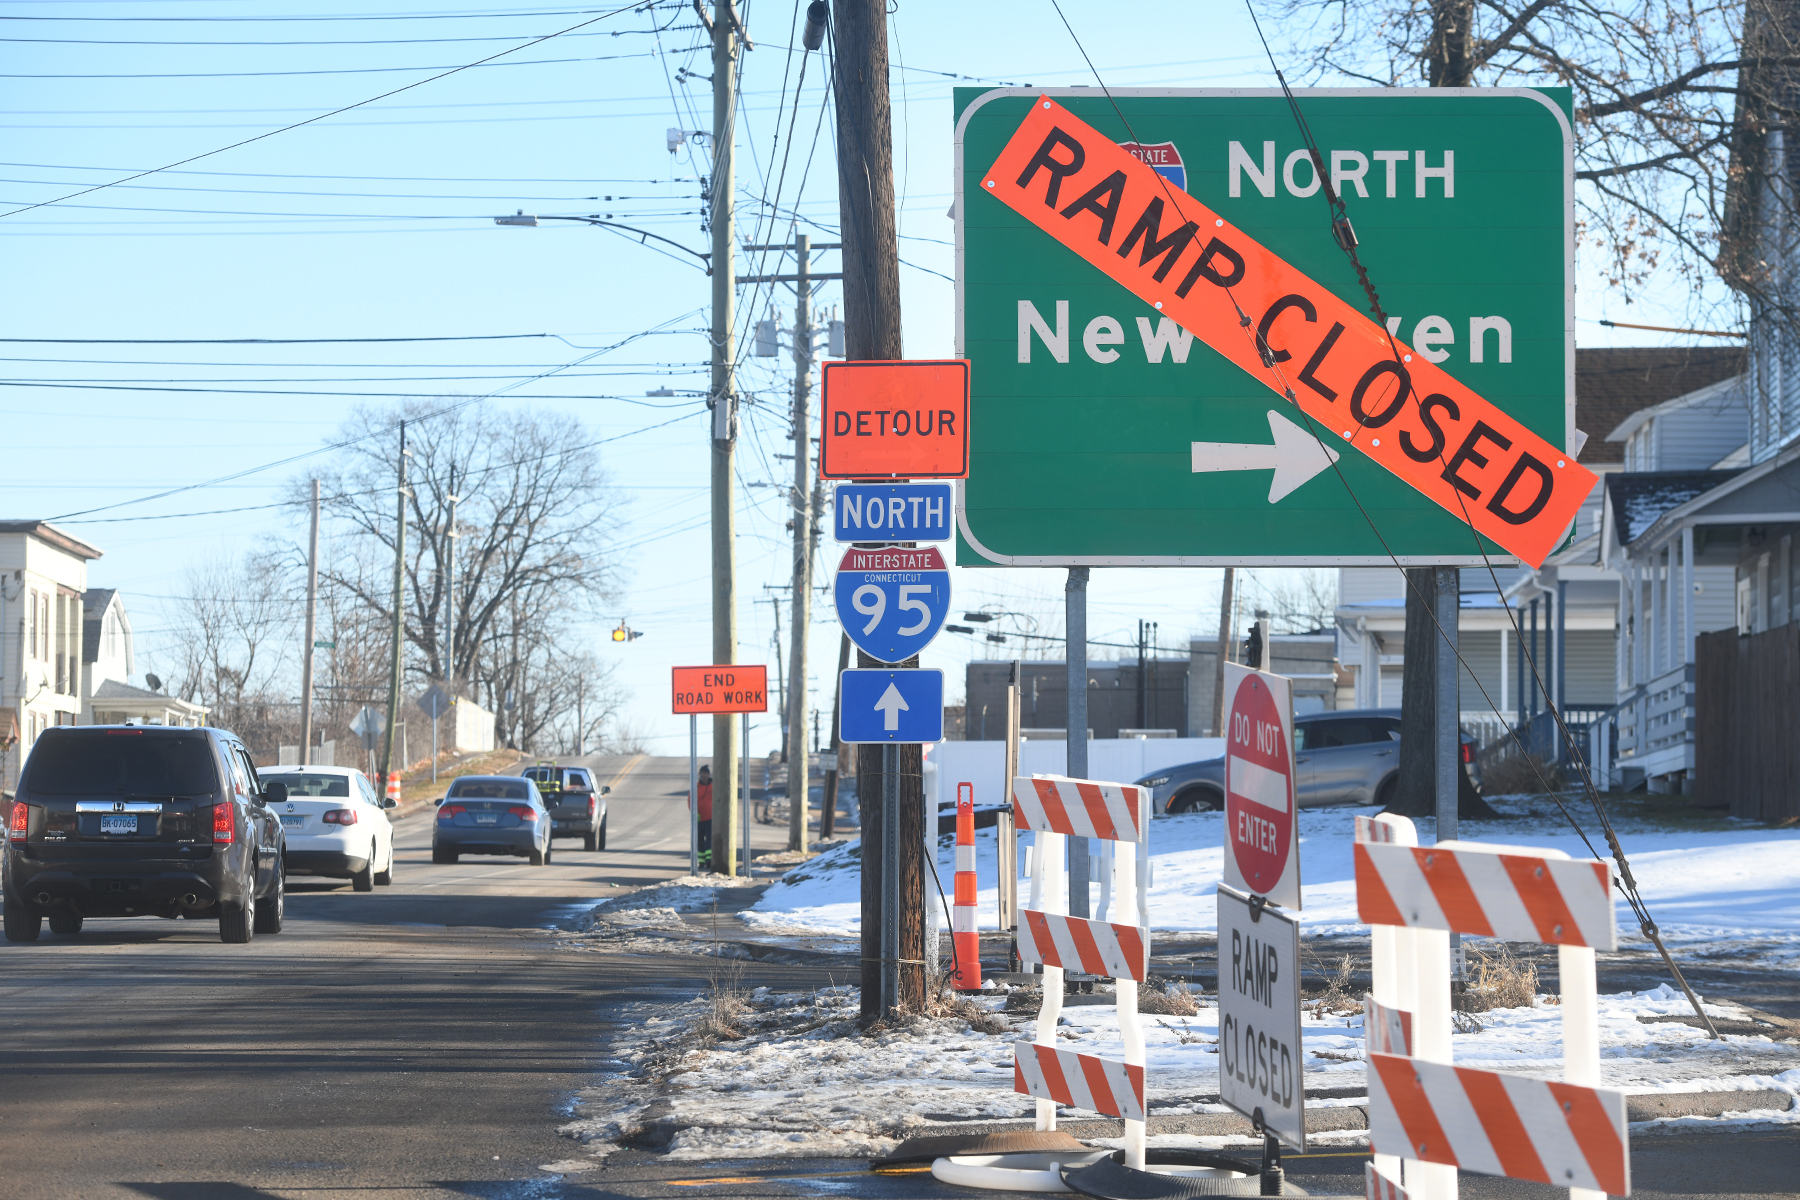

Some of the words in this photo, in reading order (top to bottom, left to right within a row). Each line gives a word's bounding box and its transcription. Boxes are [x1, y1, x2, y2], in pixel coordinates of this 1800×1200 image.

[1130, 149, 1168, 163] STATE
[1228, 140, 1455, 198] NORTH
[1015, 125, 1246, 300] RAMP
[1255, 293, 1555, 526] CLOSED
[1017, 300, 1195, 364] New
[834, 410, 956, 437] DETOUR
[842, 494, 944, 529] NORTH
[853, 553, 932, 569] INTERSTATE
[864, 573, 922, 583] CONNECTICUT
[851, 584, 932, 637] 95
[676, 692, 714, 705] ROAD
[723, 690, 763, 704] WORK
[704, 673, 735, 687] END
[1235, 711, 1250, 747] DO
[1256, 719, 1279, 758] NOT
[1238, 810, 1277, 855] ENTER
[1232, 927, 1278, 1009] RAMP
[1224, 1012, 1293, 1109] CLOSED
